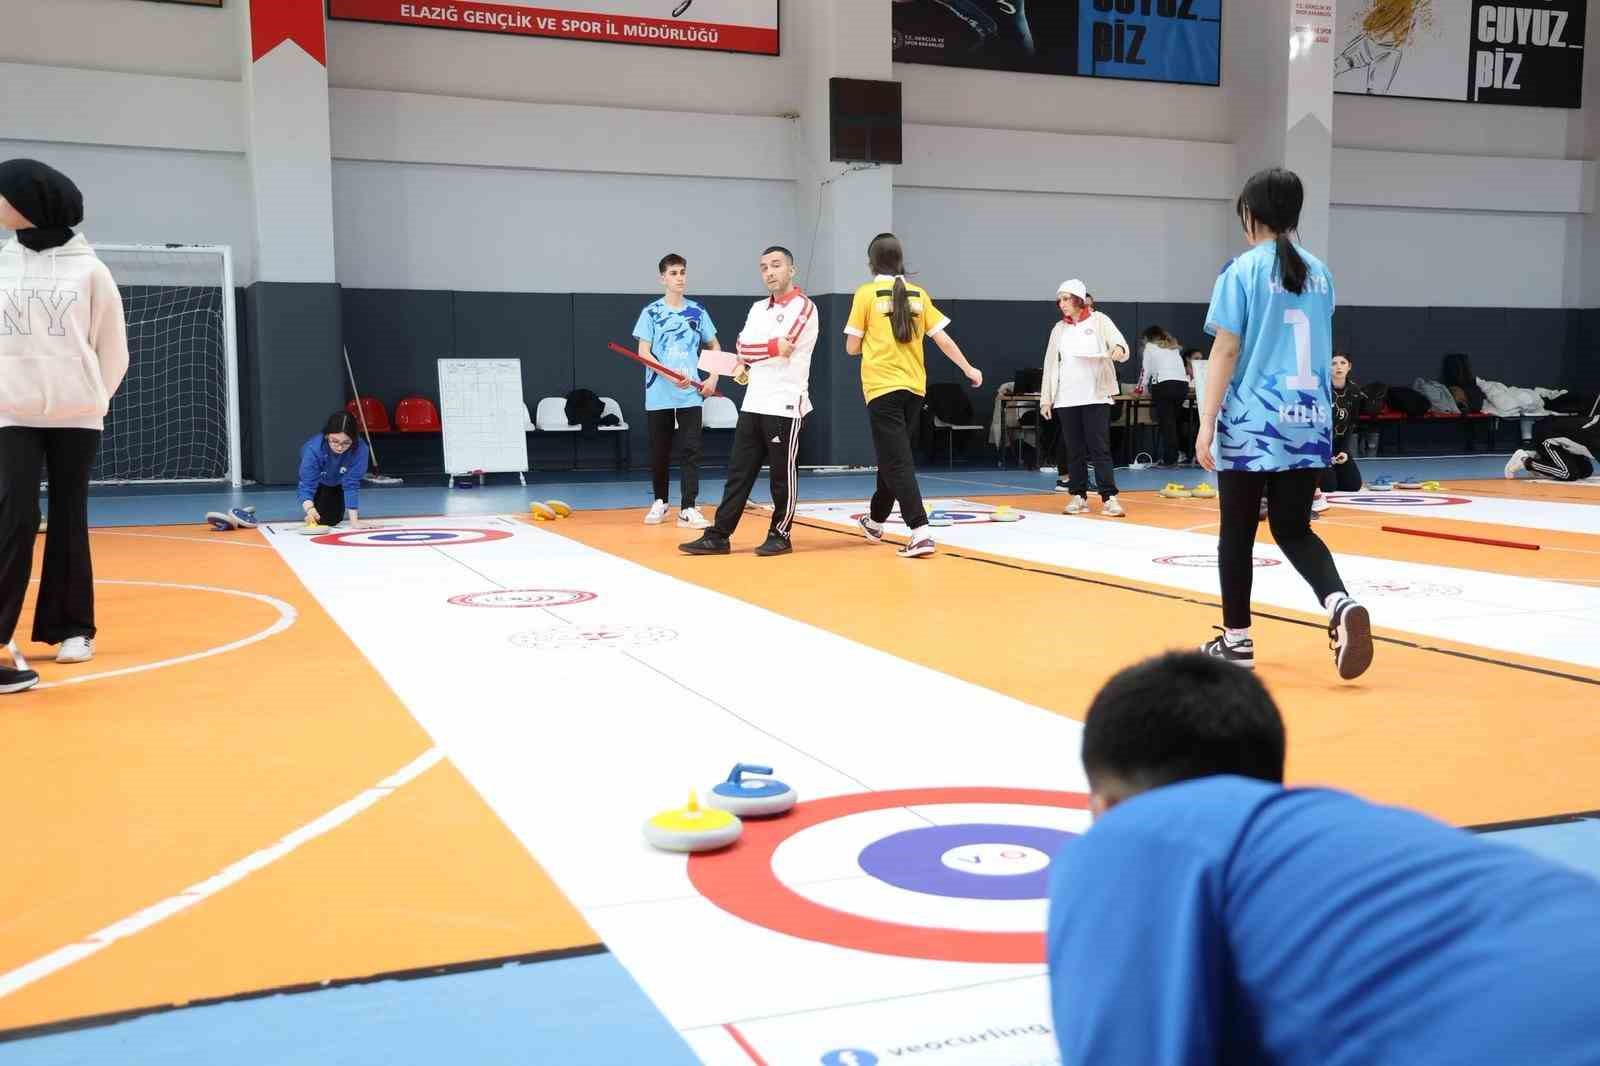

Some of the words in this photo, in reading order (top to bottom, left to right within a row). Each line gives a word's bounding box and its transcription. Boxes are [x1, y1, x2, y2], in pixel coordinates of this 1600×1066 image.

[400, 4, 459, 22] ELAZIĞ
[463, 10, 531, 30] GENÇLİK
[535, 17, 557, 31] VE
[561, 18, 602, 34] SPOR
[606, 20, 619, 36] İL
[623, 23, 719, 43] MÜDÜRLÜĞÜ
[1092, 20, 1146, 75] BİZ
[1474, 48, 1522, 101] BİZ
[1284, 309, 1320, 390] 1
[1279, 400, 1328, 424] KİLİS
